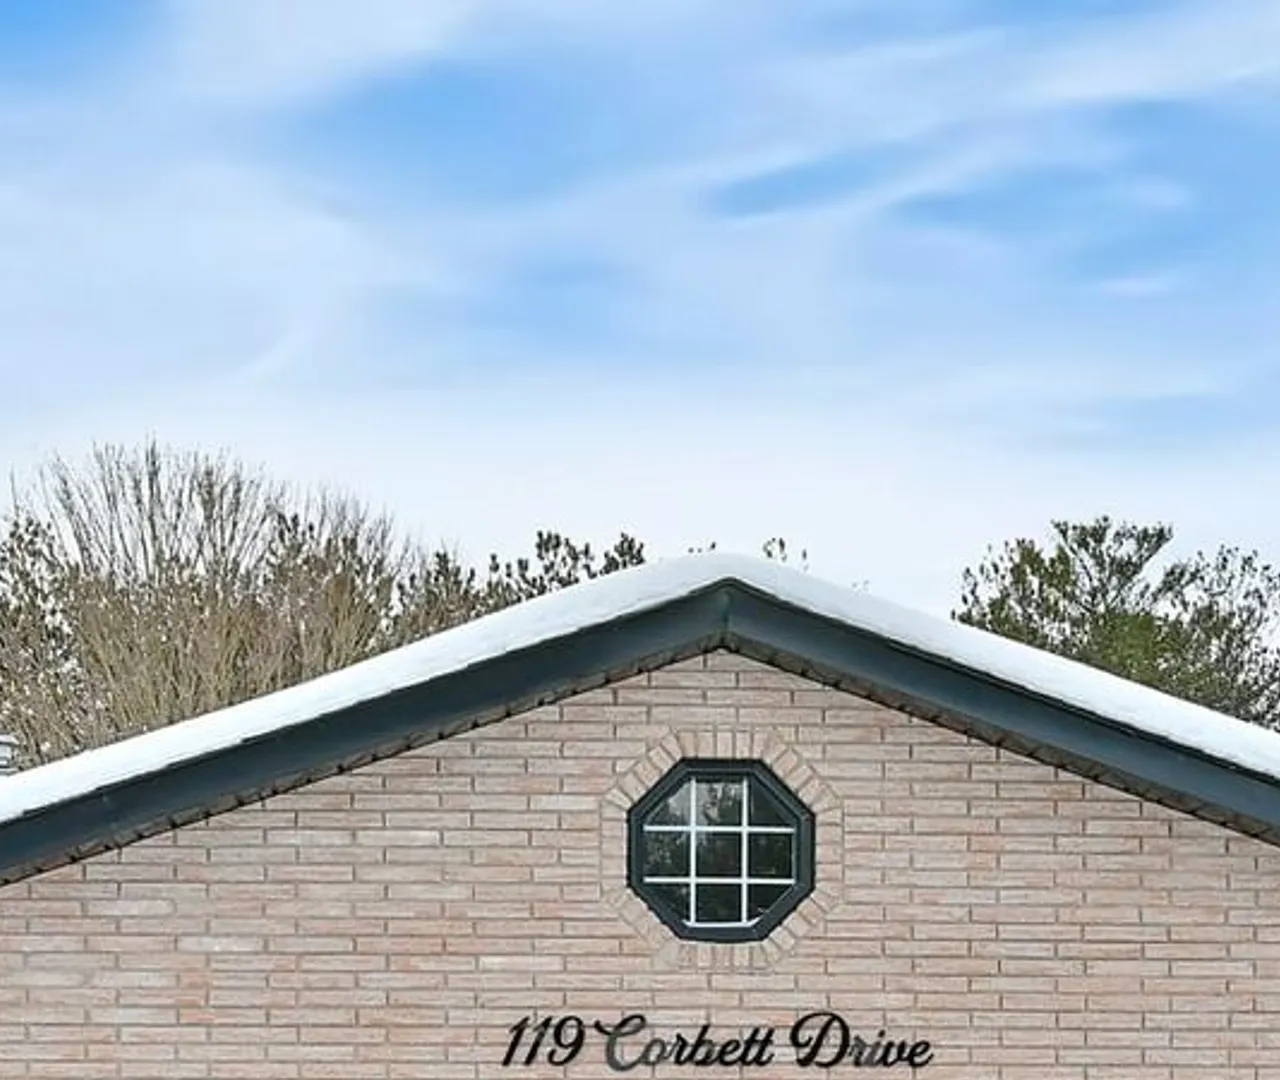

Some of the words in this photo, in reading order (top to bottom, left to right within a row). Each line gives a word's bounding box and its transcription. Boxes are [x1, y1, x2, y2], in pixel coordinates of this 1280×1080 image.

[501, 1015, 586, 1067] 119
[593, 1013, 776, 1072] Corbett
[789, 1011, 935, 1068] Drive
